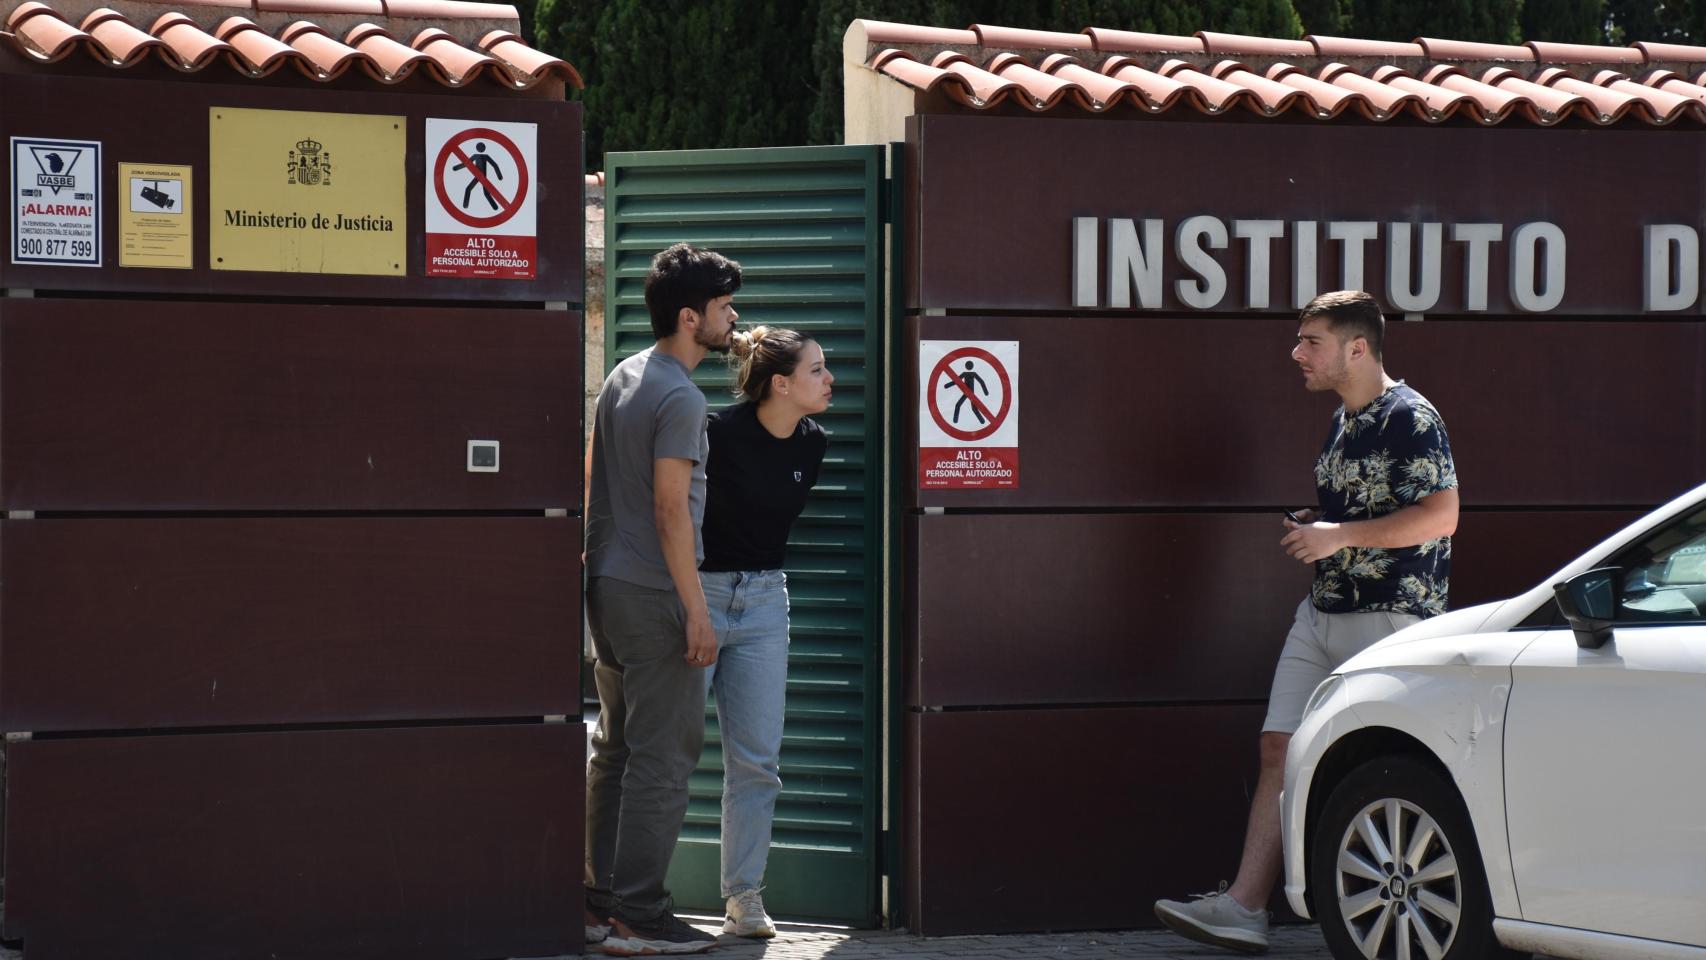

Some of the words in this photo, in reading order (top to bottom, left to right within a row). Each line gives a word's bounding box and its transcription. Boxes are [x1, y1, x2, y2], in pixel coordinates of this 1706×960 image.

[40, 176, 72, 185] VASBE
[22, 203, 92, 217] ¡ALARMA!
[224, 209, 306, 229] Ministerio
[311, 213, 330, 230] de
[334, 214, 393, 232] Justicia
[21, 238, 42, 255] 900
[46, 240, 67, 256] 877
[71, 240, 92, 257] 599
[467, 238, 496, 249] ALTO
[444, 248, 486, 257] ACCESIBLE
[488, 250, 510, 258] SOLO
[432, 257, 475, 266] PERSONAL
[476, 259, 529, 268] AUTORIZADO
[1072, 215, 1567, 312] INSTITUTO
[956, 450, 982, 460] ALTO
